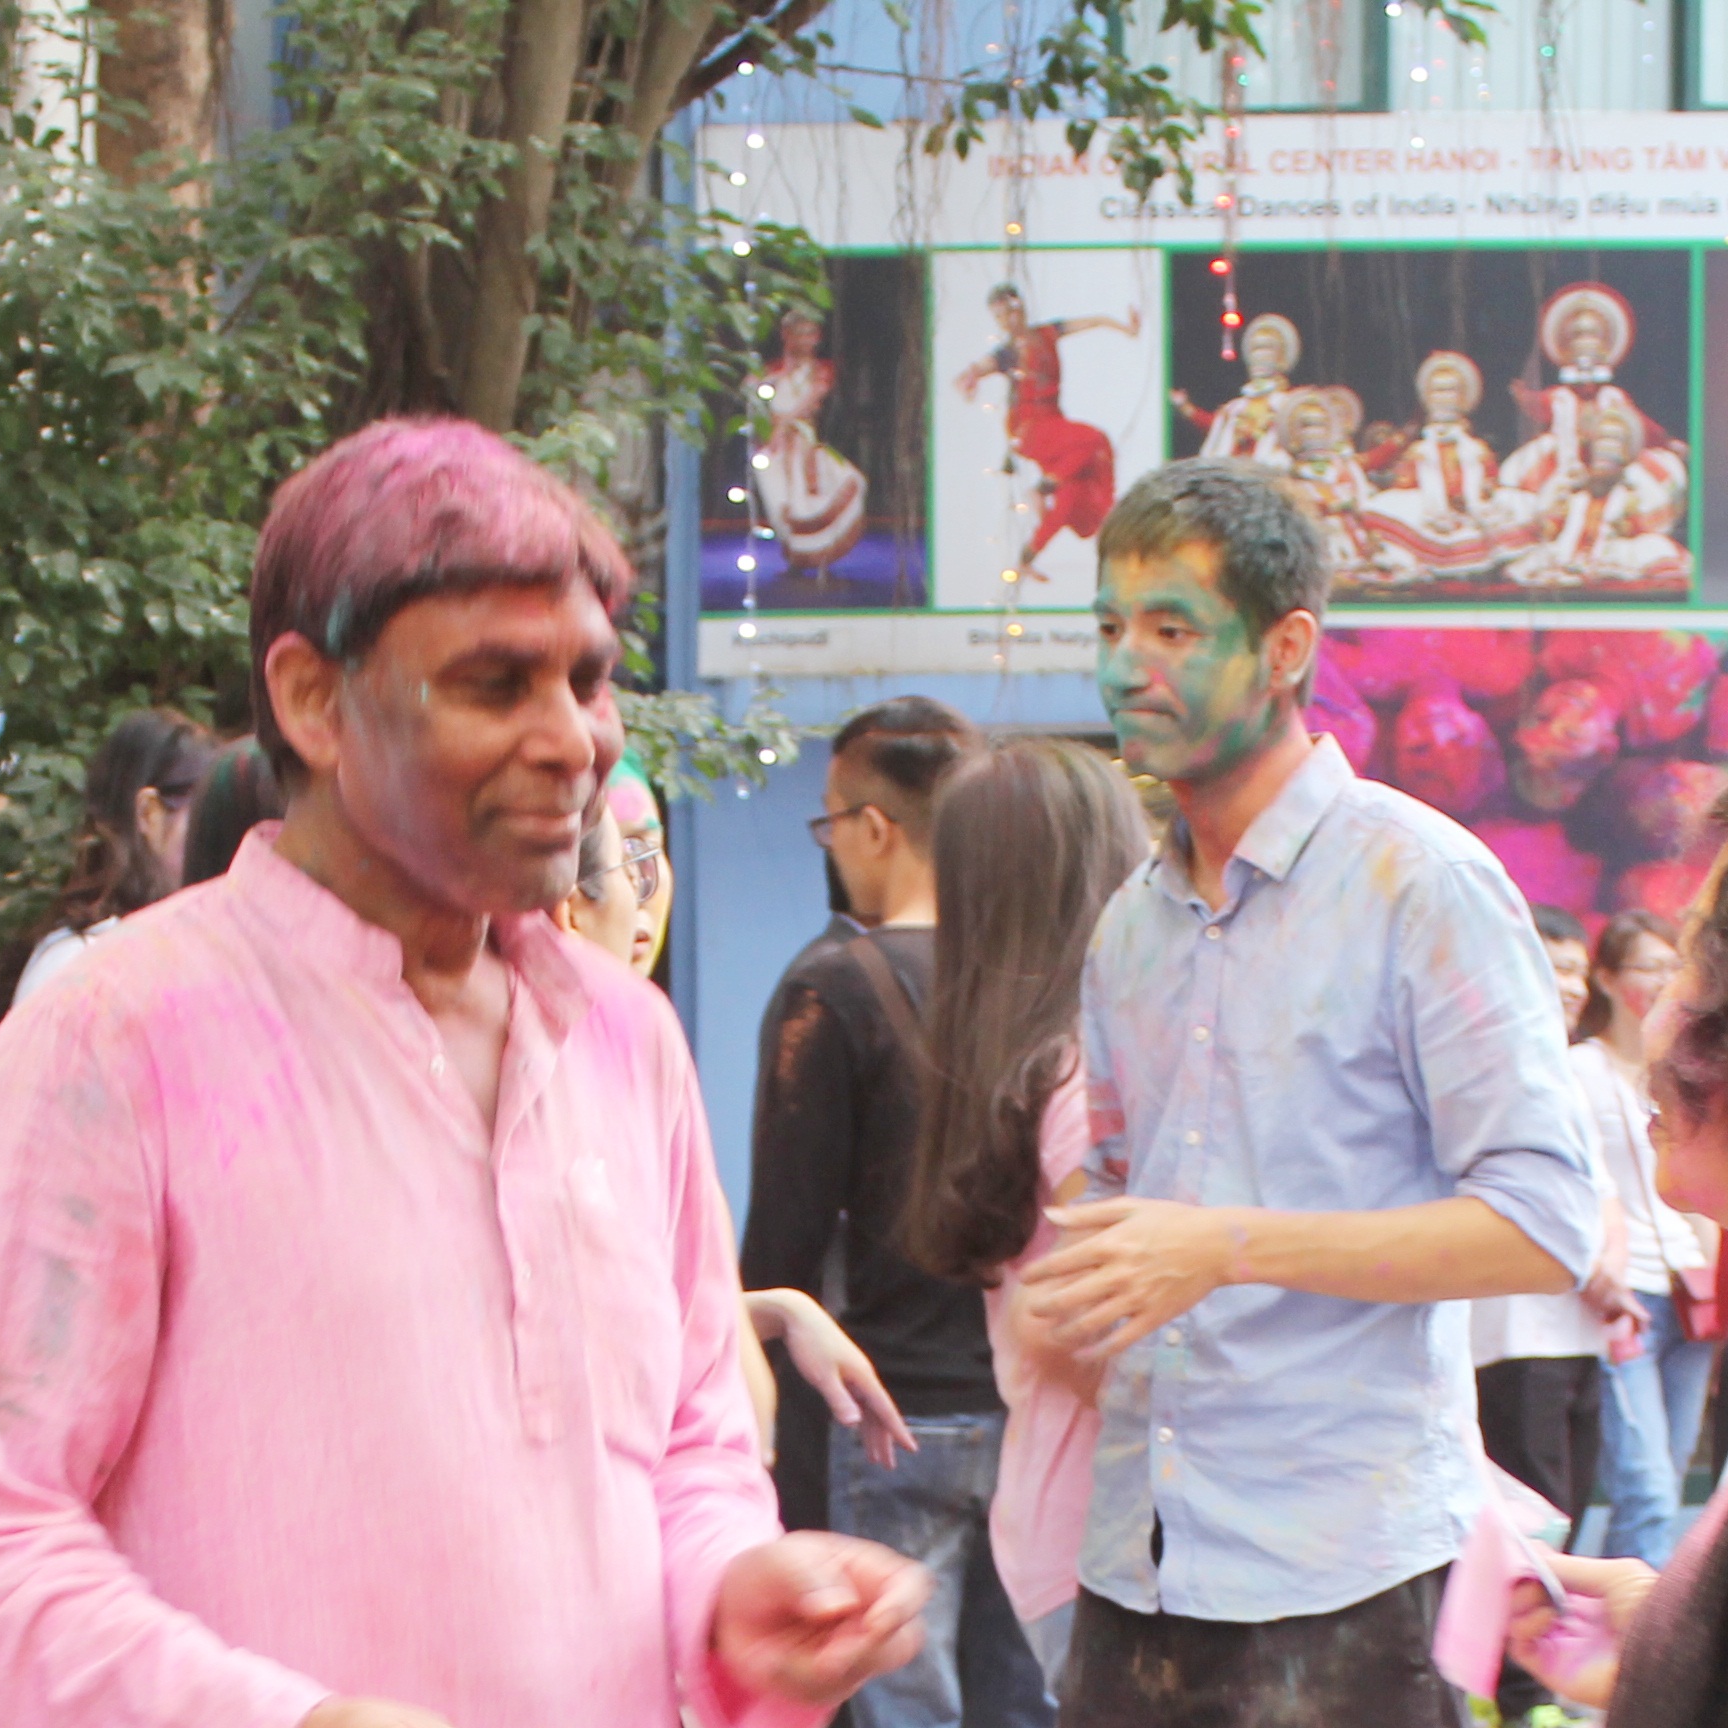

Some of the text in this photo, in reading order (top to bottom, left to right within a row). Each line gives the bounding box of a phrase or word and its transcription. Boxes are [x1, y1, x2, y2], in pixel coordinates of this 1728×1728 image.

[987, 155, 1088, 177] INDIAN
[1269, 148, 1397, 174] CENTER
[1405, 147, 1500, 172] HANOI
[1528, 147, 1633, 172] TRUNG
[1237, 196, 1340, 217] Dances
[1354, 195, 1378, 216] of
[1387, 194, 1456, 216] India
